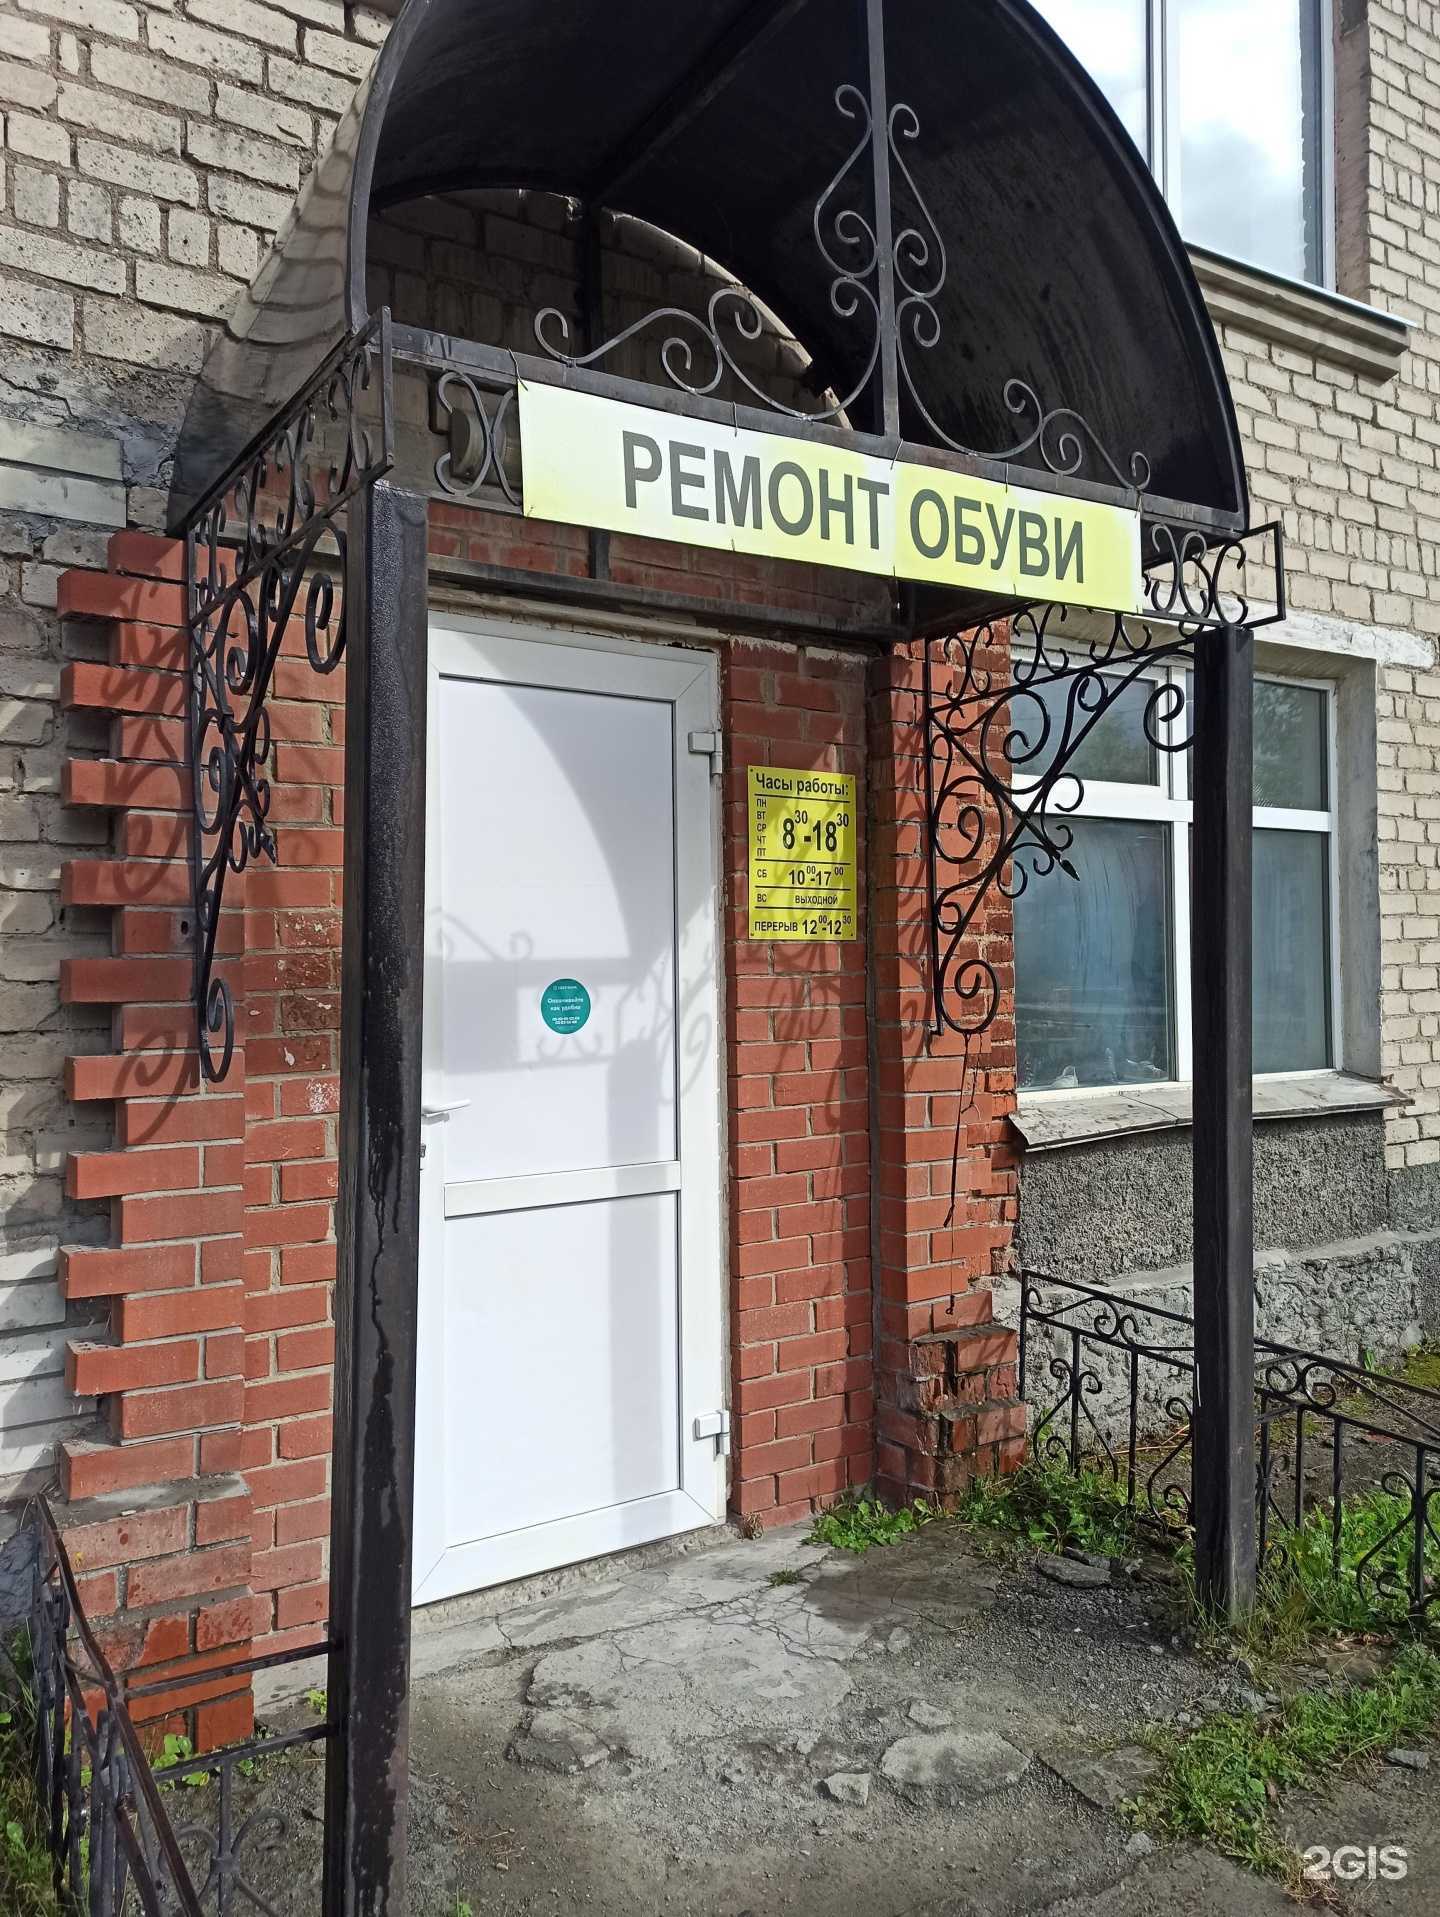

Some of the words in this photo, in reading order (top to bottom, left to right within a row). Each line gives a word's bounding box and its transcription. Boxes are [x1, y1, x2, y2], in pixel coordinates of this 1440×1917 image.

[621, 429, 890, 551] РЕМОНТ
[909, 488, 1085, 584] ОБУВИ
[756, 773, 793, 791] Часы
[797, 778, 849, 796] работы:
[757, 799, 767, 808] ПН
[757, 811, 766, 820] ВТ
[757, 823, 767, 832] СР
[757, 836, 767, 845] ЧТ
[757, 848, 767, 857] ПТ
[757, 869, 768, 878] СБ
[757, 894, 767, 903] ВС
[795, 895, 838, 906] ВЫХОДНОЙ
[755, 922, 798, 932] ПЕРЕРЫВ
